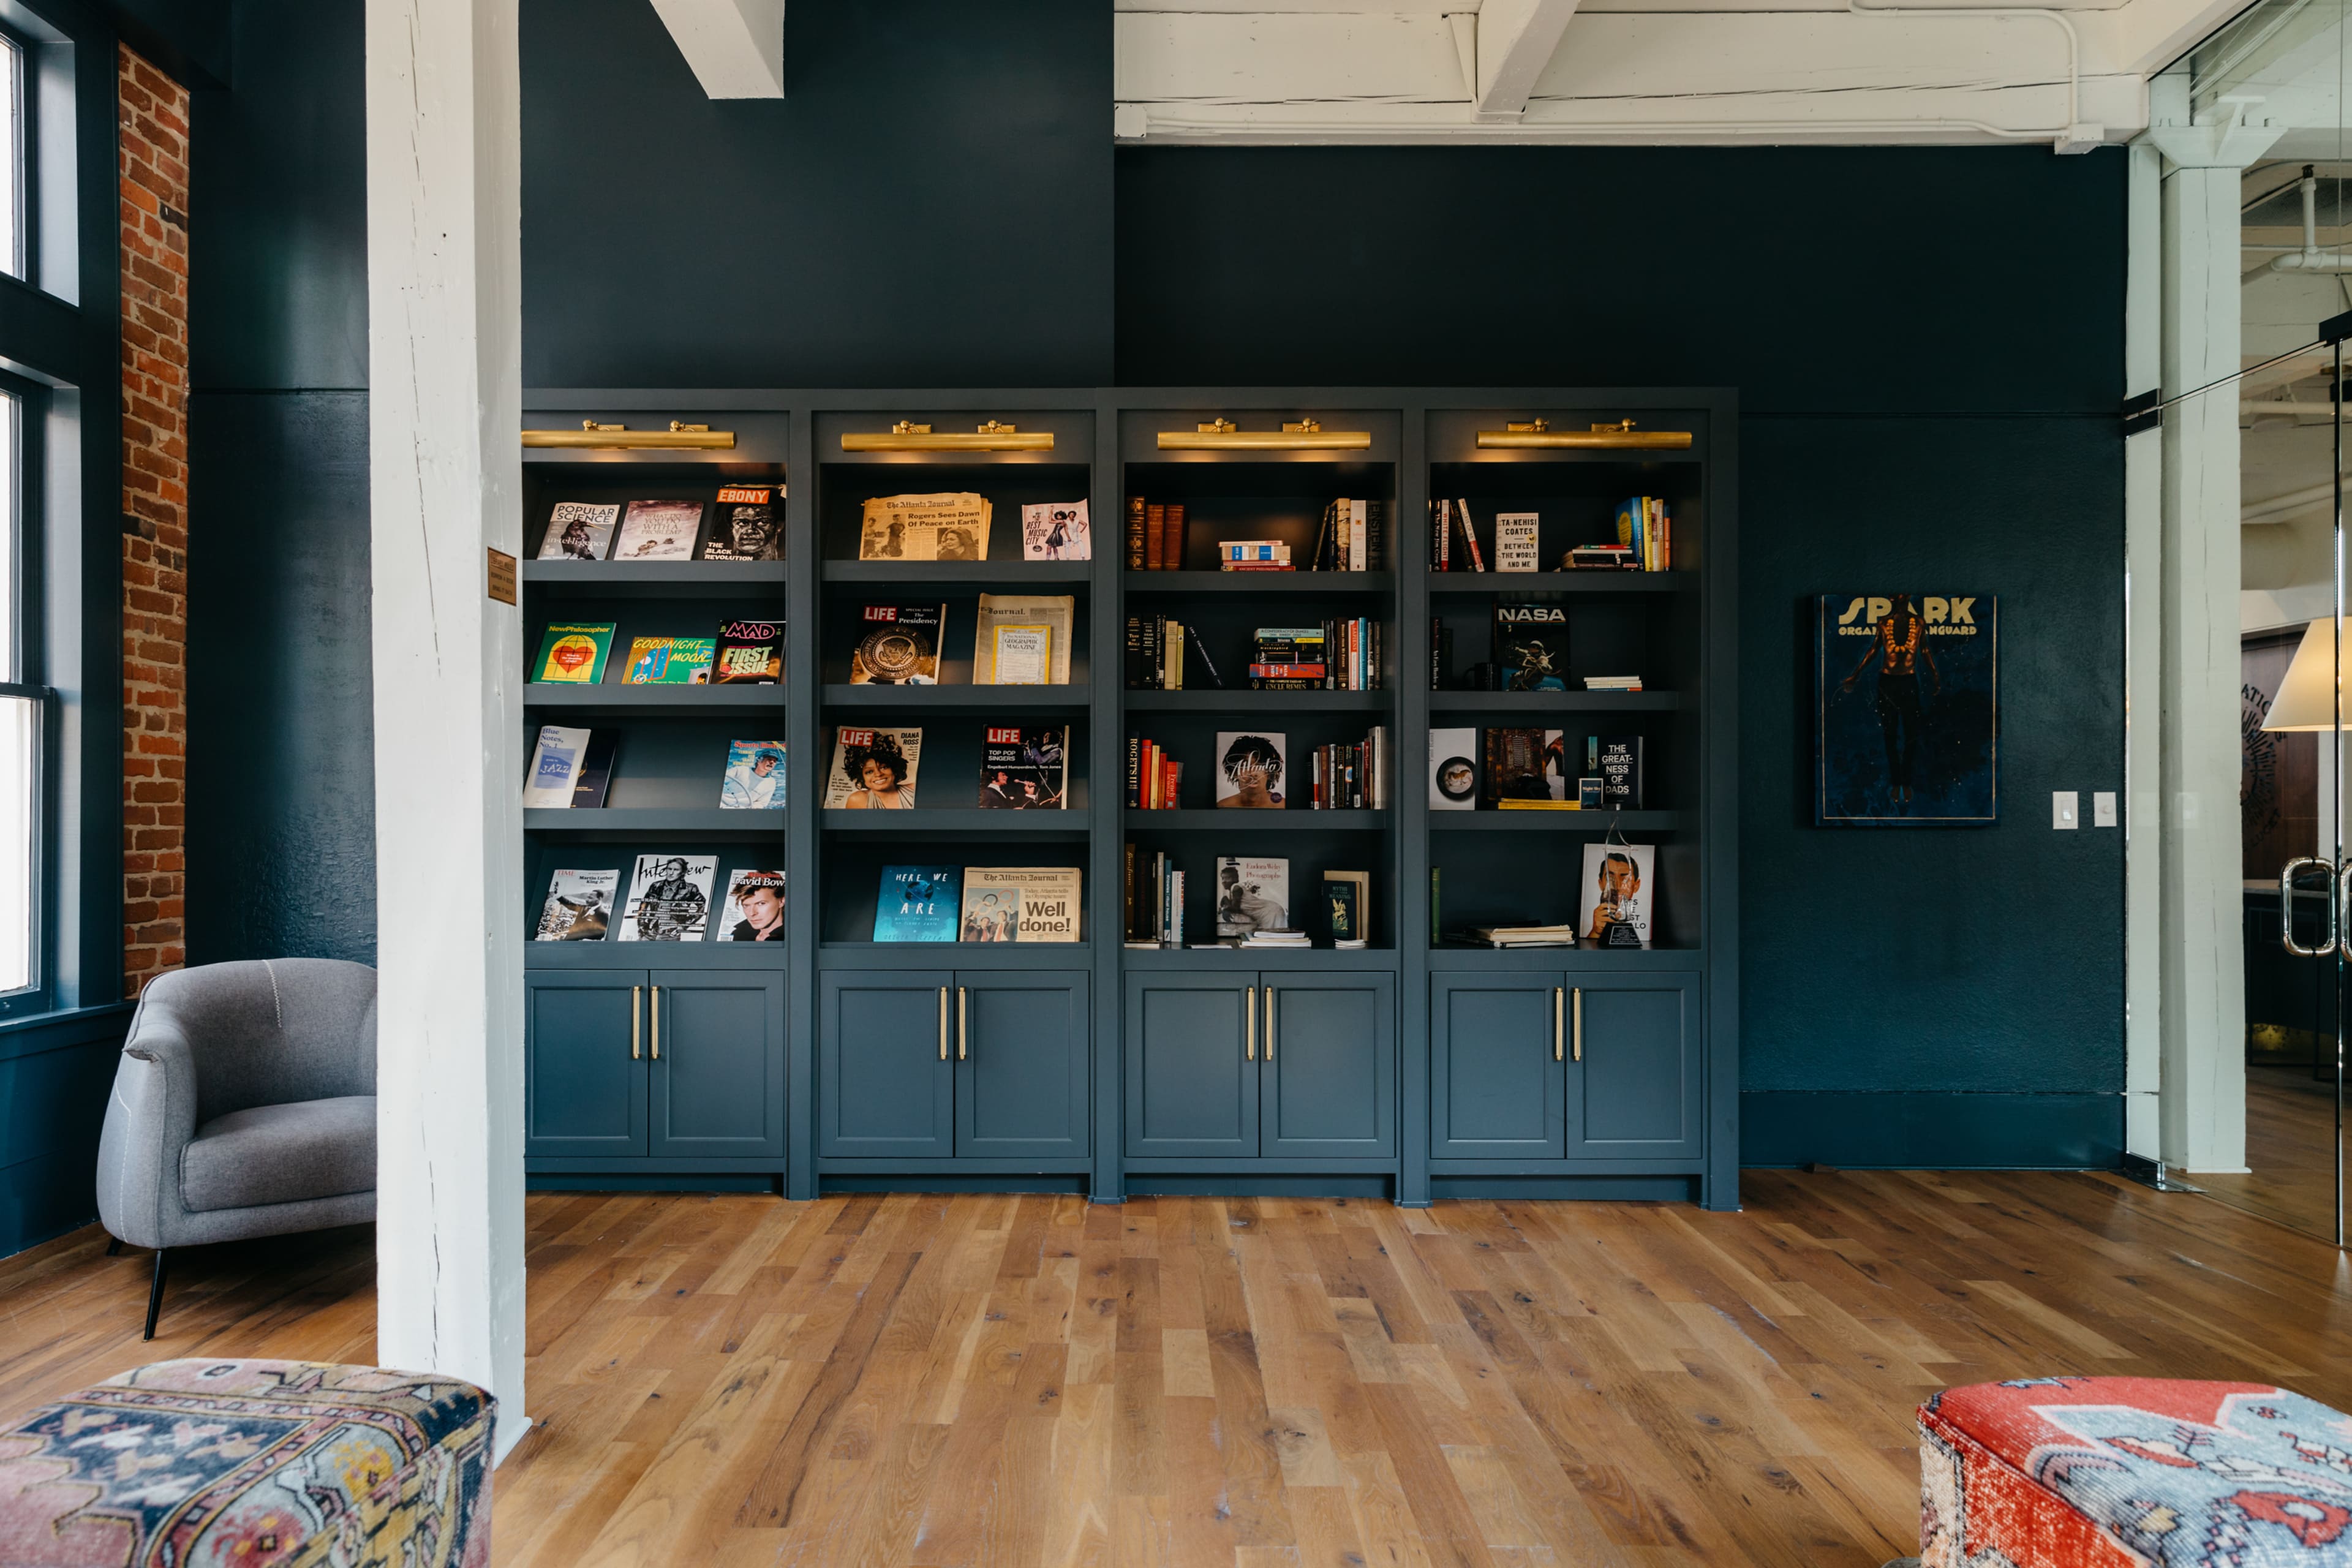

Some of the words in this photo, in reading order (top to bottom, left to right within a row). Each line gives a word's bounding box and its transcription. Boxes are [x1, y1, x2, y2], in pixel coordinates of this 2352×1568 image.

[718, 490, 767, 503] EBONY
[557, 505, 614, 516] POPULAR
[557, 513, 611, 523] SCIENCE
[1371, 505, 1381, 552] EINSTEIN
[865, 608, 895, 620] LIFE
[1498, 608, 1566, 621] NASA
[1839, 597, 1977, 625] SPRK
[725, 622, 775, 639] MAD
[633, 639, 702, 650] GOODNIGHT
[671, 653, 707, 662] MOON
[723, 647, 773, 662] FIRST
[728, 662, 769, 674] ISSUE
[841, 731, 873, 745] LIFE
[989, 729, 1019, 742] LIFE
[540, 764, 570, 774] JAZZ
[732, 876, 761, 886] David
[764, 878, 785, 887] Bow
[900, 902, 935, 914] ARE
[1025, 902, 1065, 917] Well
[1019, 918, 1071, 932] done!
